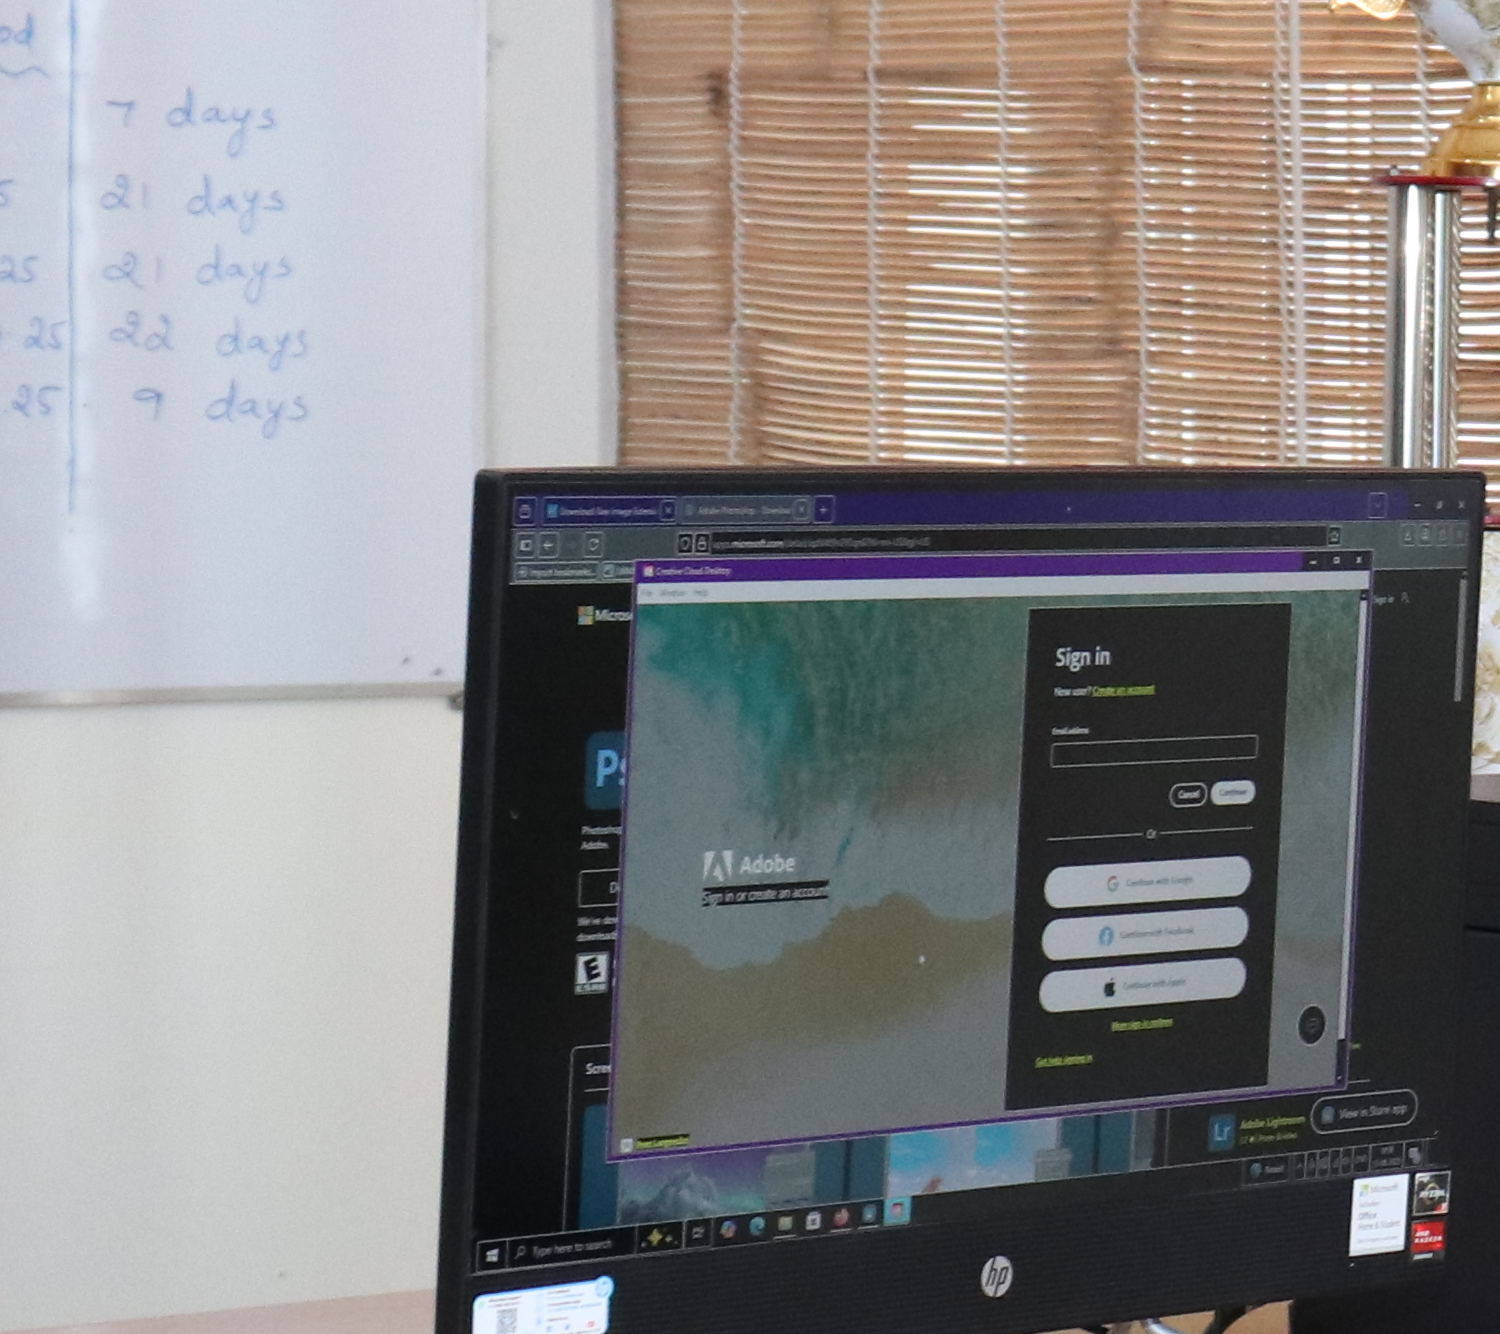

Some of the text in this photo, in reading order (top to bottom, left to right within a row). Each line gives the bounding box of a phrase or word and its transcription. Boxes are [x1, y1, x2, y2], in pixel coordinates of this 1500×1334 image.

[105, 85, 280, 158] 7 days
[100, 173, 288, 236] 21 days
[102, 243, 295, 304] 21 days
[109, 309, 312, 374] 22 days
[132, 378, 311, 441] 9 days
[1055, 646, 1111, 673] Sign in
[739, 854, 796, 875] Adobe
[532, 1244, 552, 1259] Type
[983, 1255, 1012, 1298] hp
